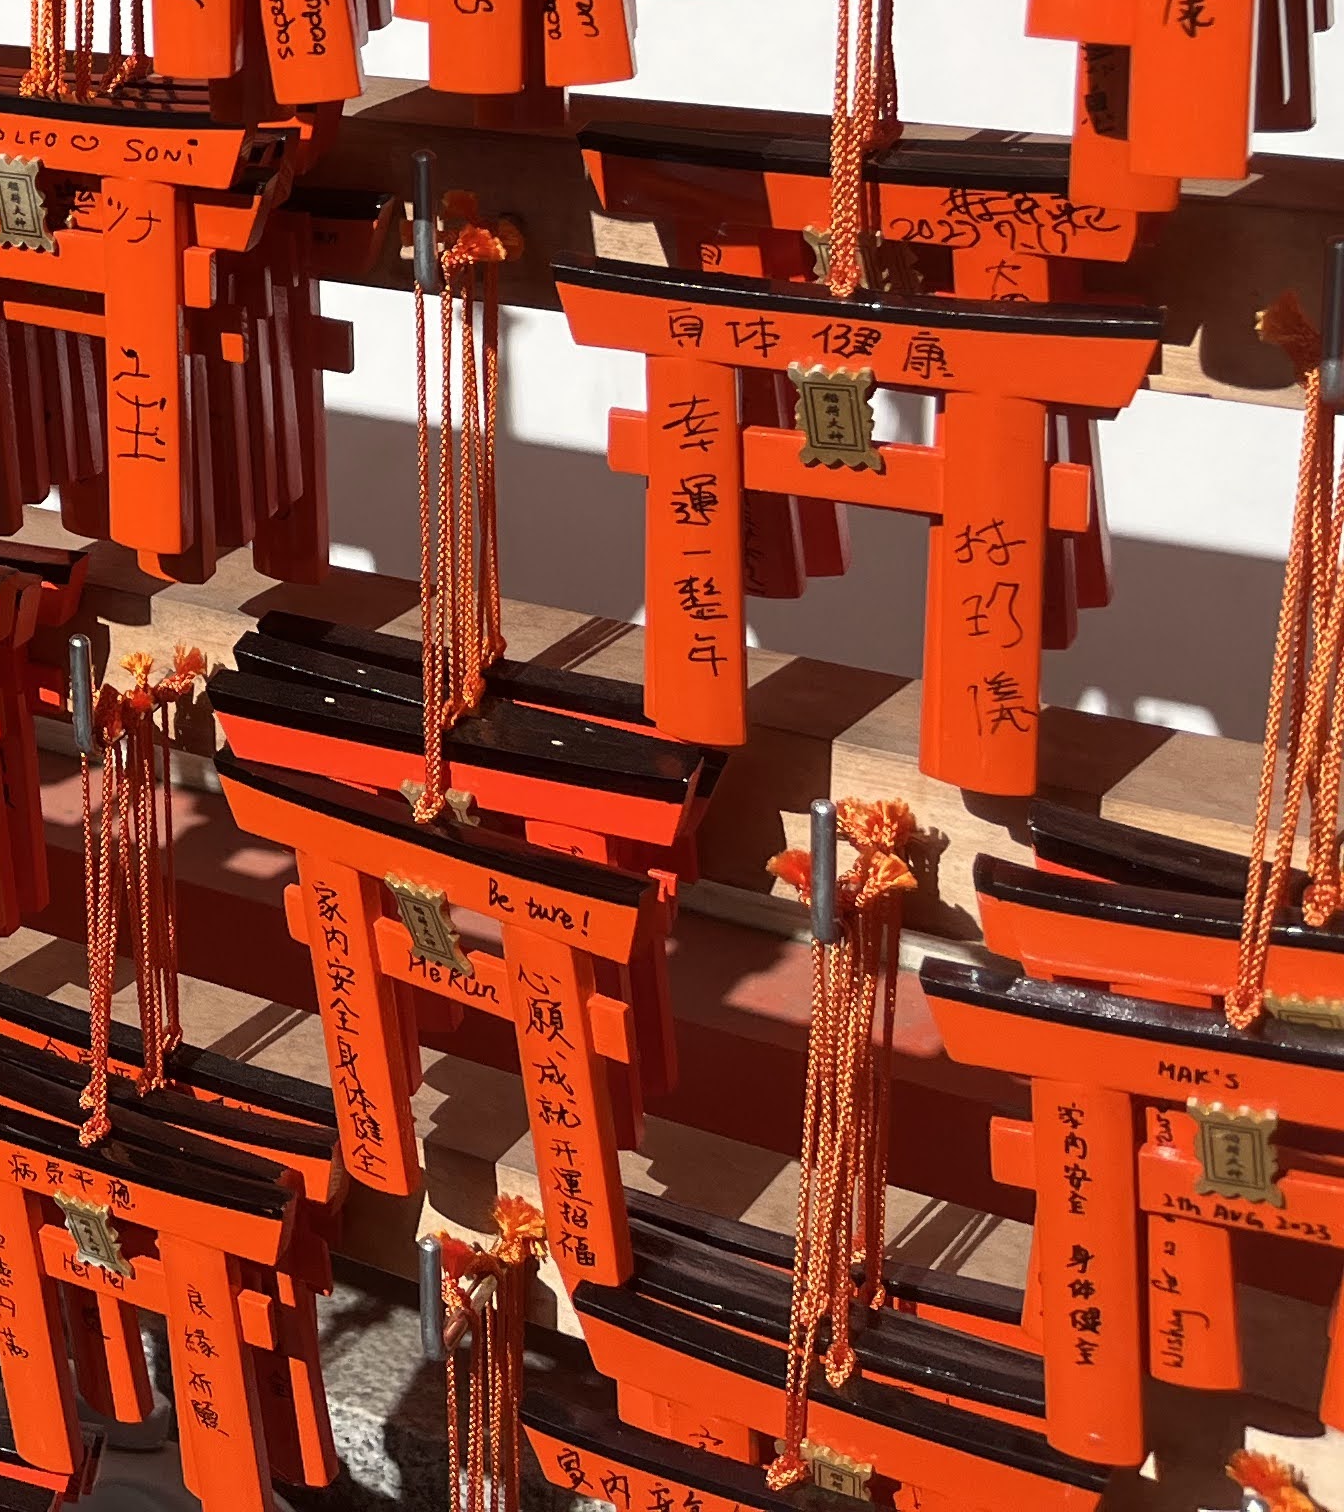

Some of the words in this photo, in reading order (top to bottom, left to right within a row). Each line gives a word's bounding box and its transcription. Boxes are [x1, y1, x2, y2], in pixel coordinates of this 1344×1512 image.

[665, 305, 958, 381] 身体健康
[488, 877, 516, 913] Be
[1156, 1059, 1242, 1091] MAK'S
[1213, 1203, 1266, 1232] AUG
